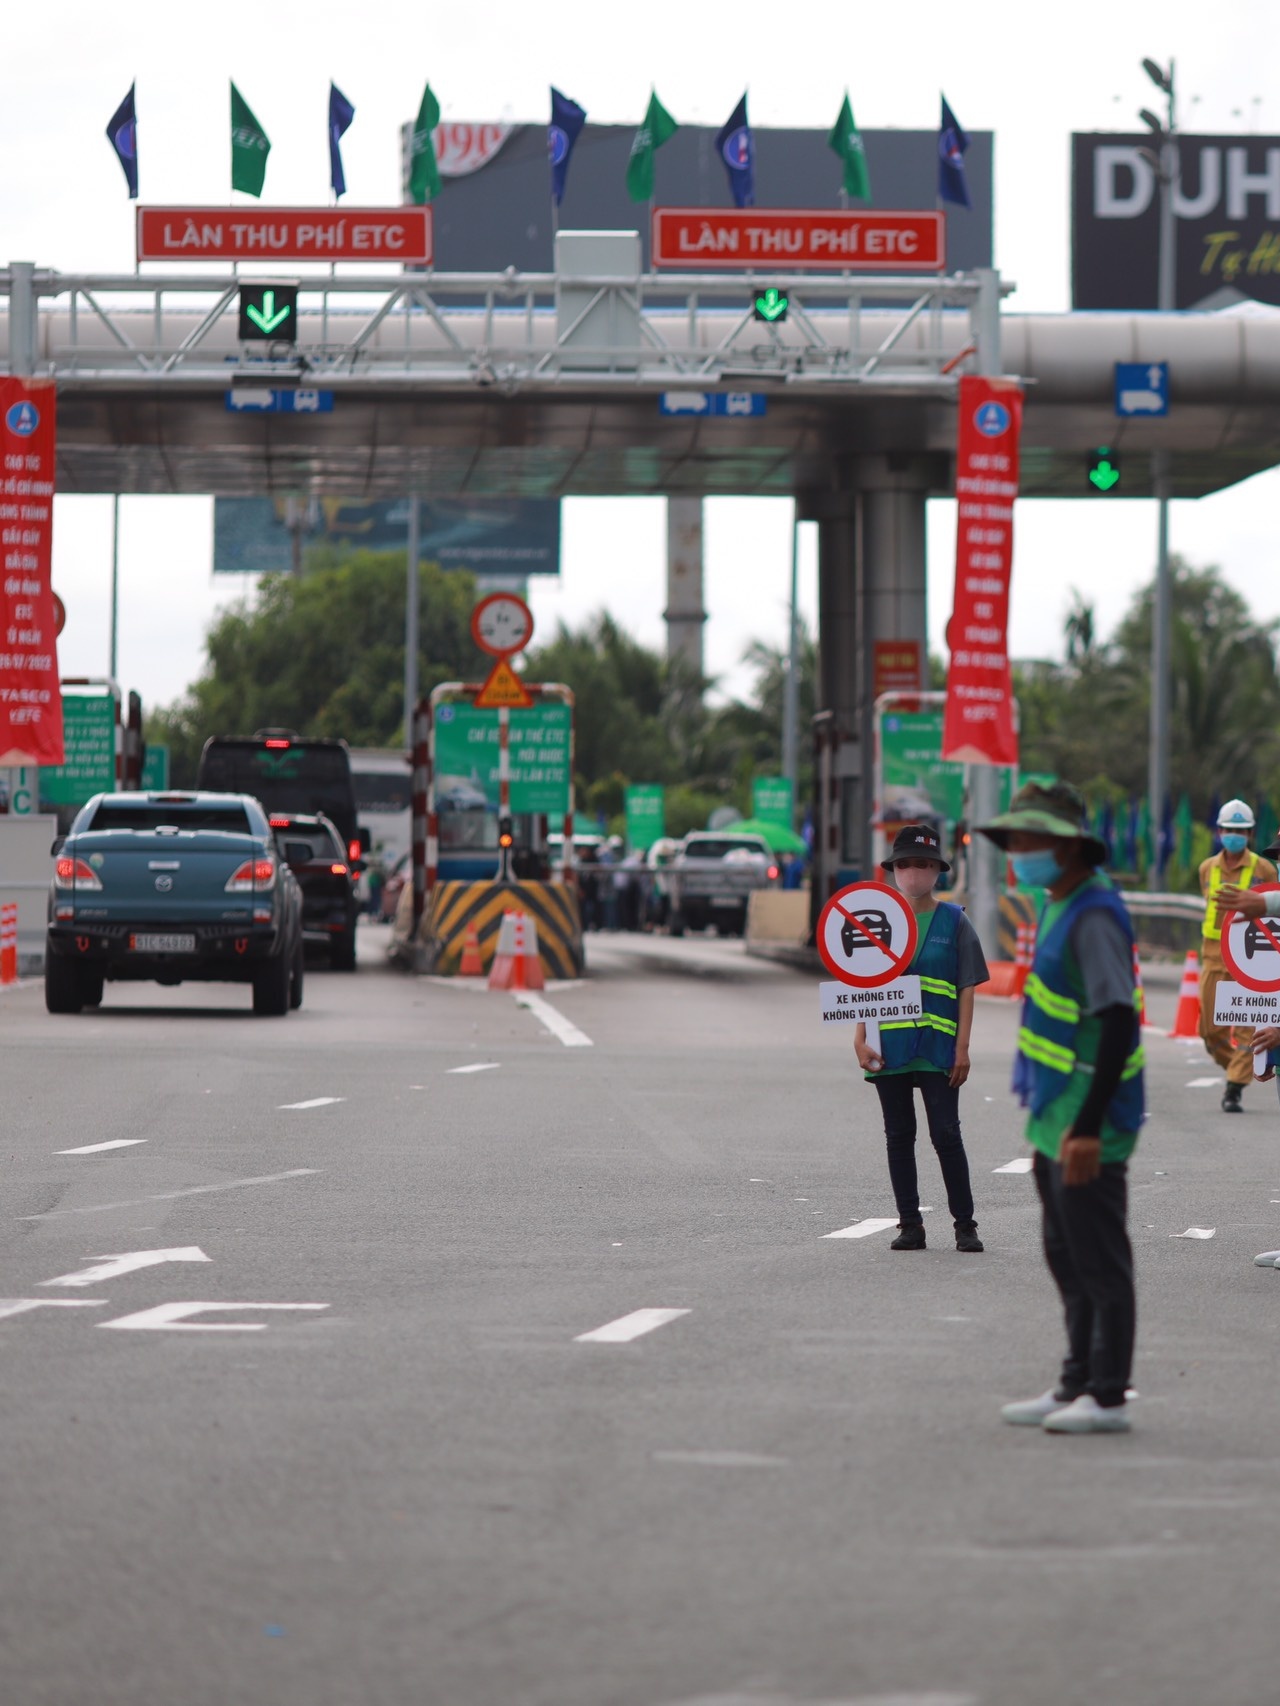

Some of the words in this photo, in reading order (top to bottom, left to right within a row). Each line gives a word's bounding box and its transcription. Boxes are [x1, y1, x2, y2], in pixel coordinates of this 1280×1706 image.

[164, 218, 223, 248] LÀN
[230, 224, 288, 248] THU
[297, 219, 346, 249] PHÍ
[352, 224, 405, 249] ETC
[679, 221, 738, 251] LÀN
[745, 227, 803, 252] THU
[810, 223, 860, 253] PHÍ
[864, 228, 918, 254] ETC
[836, 994, 848, 1004] XE
[851, 991, 884, 1003] KHÔNG
[887, 990, 904, 1001] ETC
[1231, 996, 1243, 1006] XE
[1245, 995, 1277, 1008] KHÔNG
[823, 1009, 856, 1021] KHÔNG
[858, 1007, 877, 1018] VÀO
[880, 1006, 899, 1017] CAO
[902, 1002, 920, 1014] TỐC
[1216, 1010, 1248, 1022] KHÔNG
[1250, 1011, 1268, 1023] VÀO
